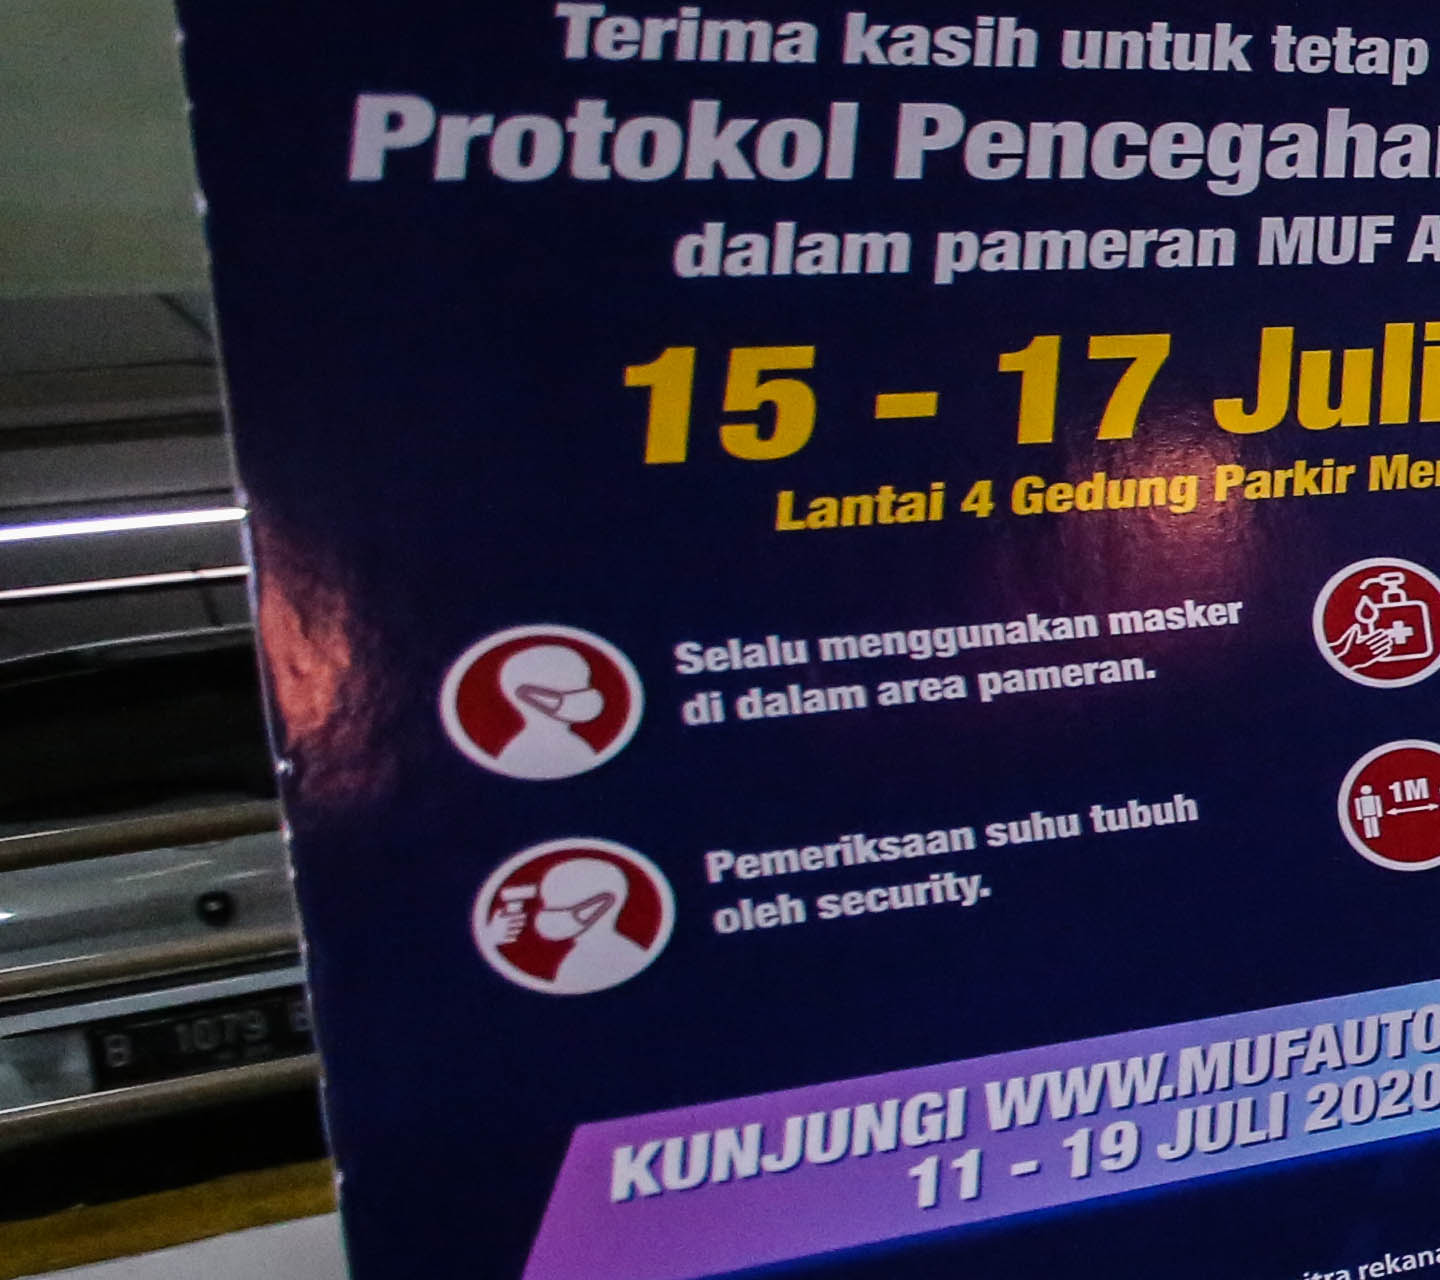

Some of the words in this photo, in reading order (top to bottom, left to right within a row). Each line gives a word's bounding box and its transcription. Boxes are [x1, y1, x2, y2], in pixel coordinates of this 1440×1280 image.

[554, 1, 818, 64] Terima
[842, 10, 1038, 68] kasih
[1061, 20, 1253, 72] untuk
[1270, 24, 1430, 86] tetap
[349, 94, 859, 182] Protokol
[673, 220, 911, 278] dalam
[933, 227, 1236, 285] pameran
[1257, 213, 1395, 265] MUF
[624, 344, 816, 464] 15
[997, 332, 1172, 444] 17
[775, 480, 948, 532] Lantai
[960, 479, 996, 519] 4
[1010, 465, 1200, 517] Gedung
[1212, 457, 1357, 504] Parkir
[673, 634, 810, 675] Selalu
[817, 611, 1100, 661] menggunakan
[1106, 598, 1243, 635] masker
[681, 689, 725, 726] di
[735, 683, 868, 720] dalam
[876, 673, 968, 706] area
[977, 656, 1157, 703] pameran.
[1388, 777, 1430, 803] 1M
[704, 826, 977, 883] Pemeriksaan
[984, 810, 1082, 847] suhu
[1088, 793, 1199, 833] tubuh
[713, 892, 807, 934] oleh
[815, 872, 992, 920] security.
[609, 1086, 969, 1204] KUNJUNGI
[908, 1147, 984, 1210] 11
[1062, 1120, 1140, 1181] 19
[1156, 1091, 1289, 1162] JULI
